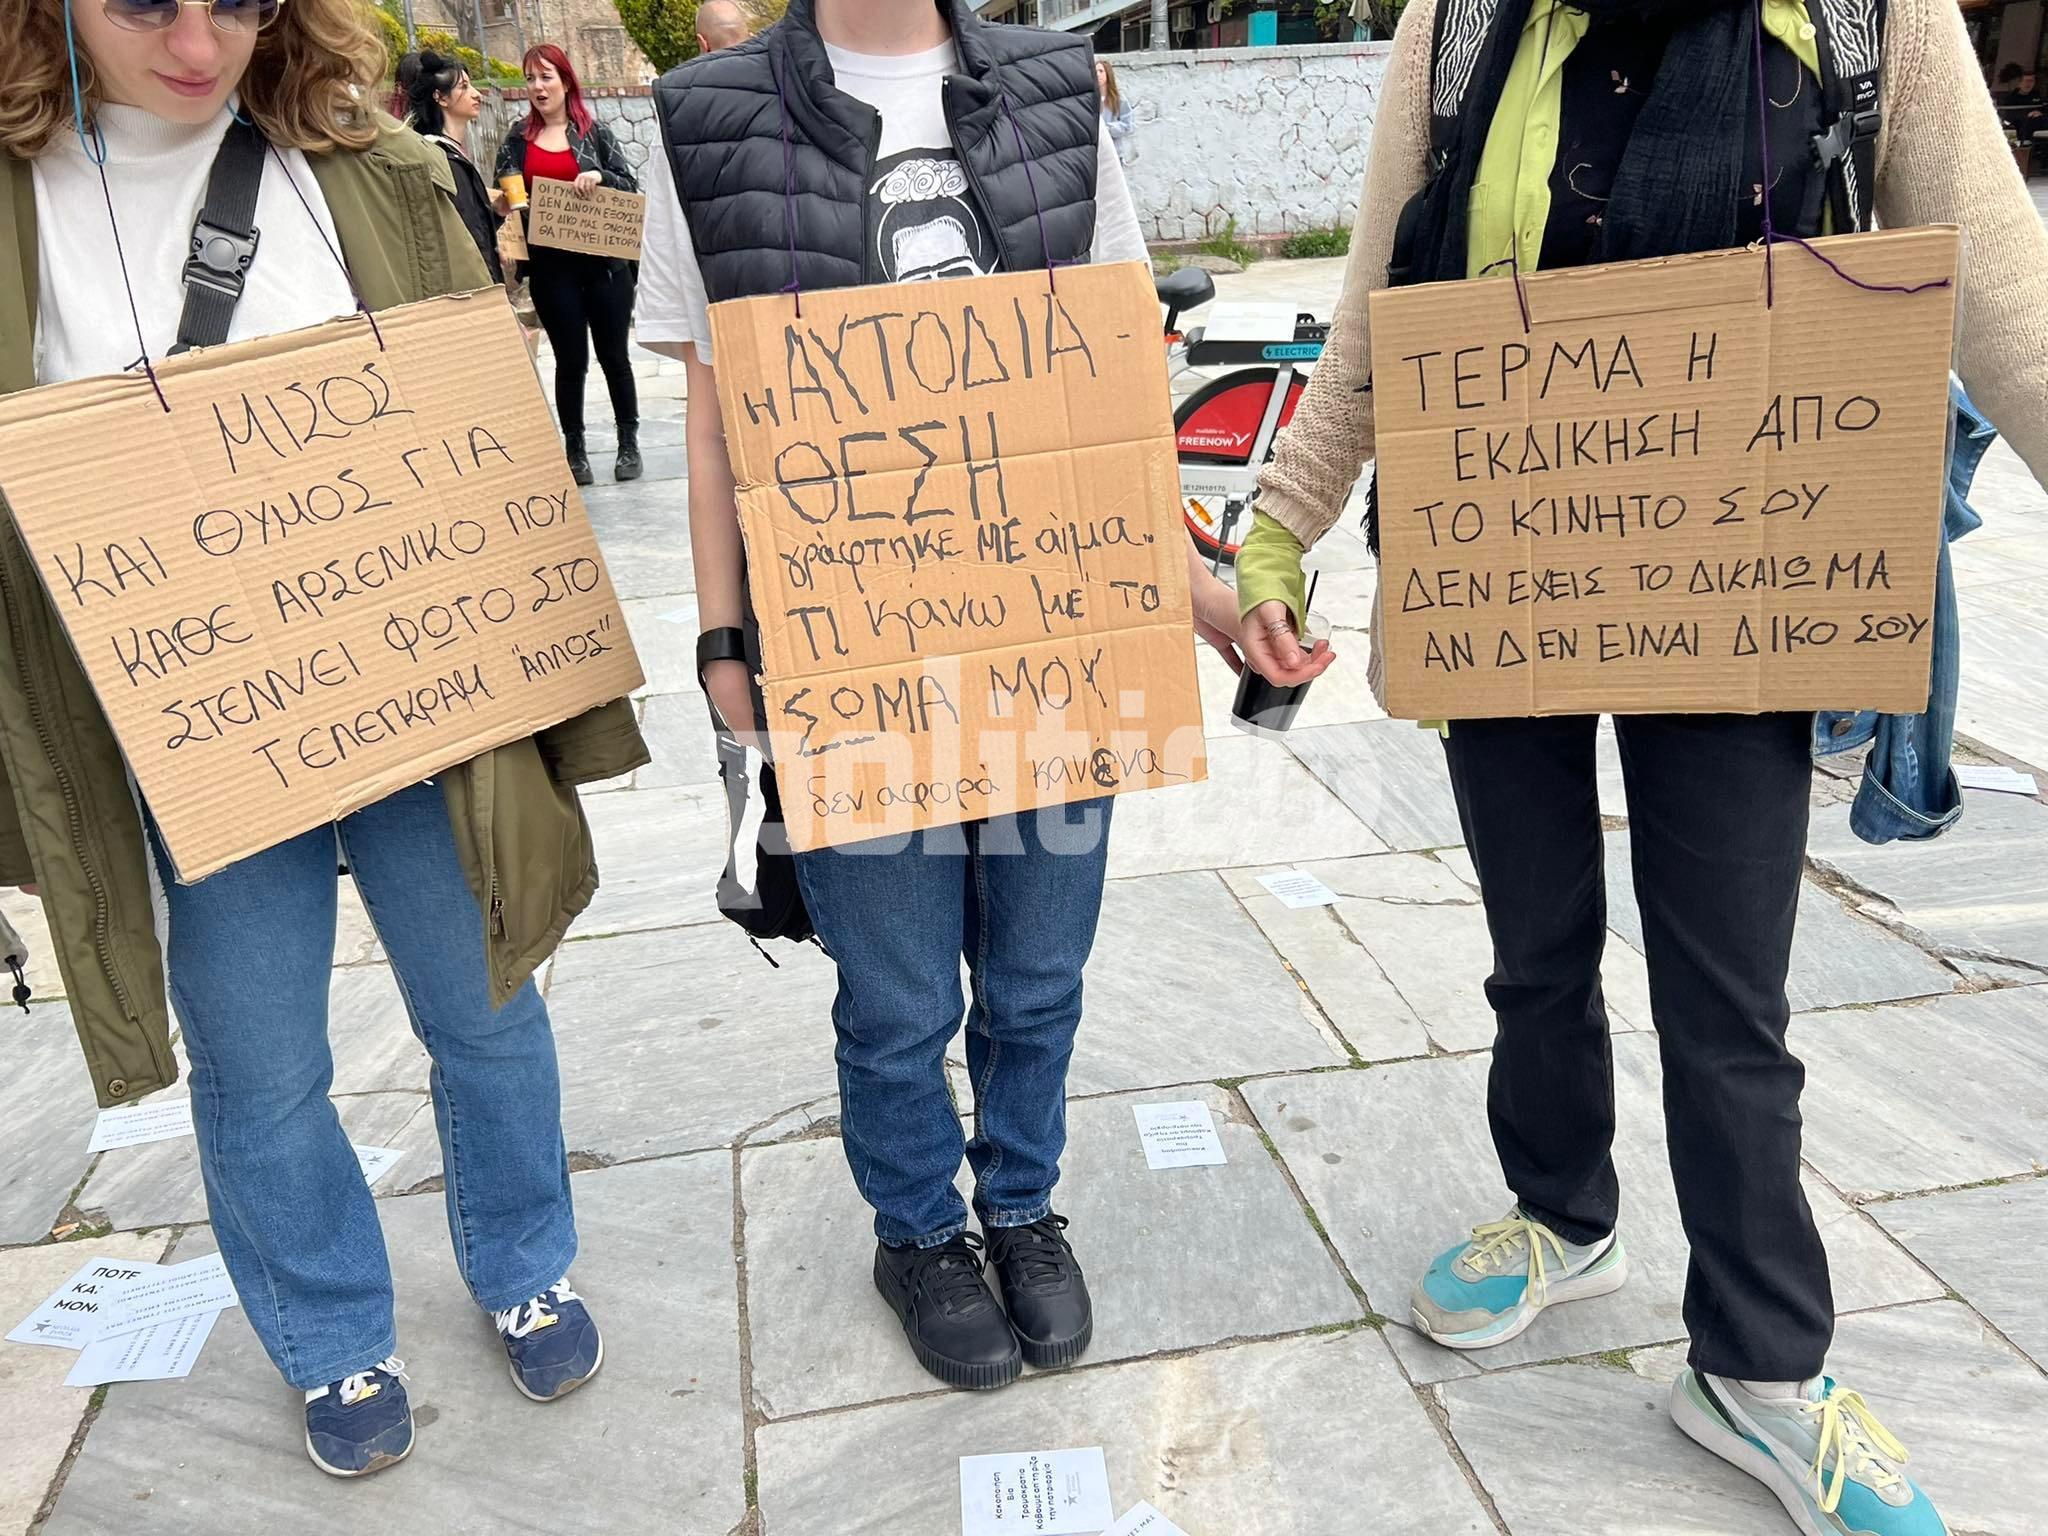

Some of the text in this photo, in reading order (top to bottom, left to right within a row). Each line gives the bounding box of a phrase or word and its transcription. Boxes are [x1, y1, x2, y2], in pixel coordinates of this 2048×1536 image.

[538, 197, 562, 209] ΔΕΝ
[564, 201, 601, 216] ΔΙΝΟΥΝ
[538, 211, 639, 237] ΤΟ ΔΙΚΟ ΜΑΣ ΟΝΟΜΑ
[539, 225, 556, 239] ΘΑ
[559, 227, 601, 244] ΓΡΑΨΕΙ
[1274, 346, 1319, 358] ELECTRIC
[1402, 332, 1718, 412] ΤΕΡΜΑ Η
[212, 362, 415, 474] ΜΙΣΟΣ
[1178, 436, 1234, 447] FREENOW
[1454, 395, 1881, 482] ΕΚΔΙΚΗΣΗ ΑΠΟ
[774, 411, 1008, 527] ΘΕΣΗ
[54, 427, 515, 606] ΚΑΙ ΘΥΜΟΣ ΓΙΑ
[1414, 483, 1830, 547] ΤΟ ΚΙΝΗΤΟ ΣΟΥ
[111, 489, 570, 688] ΚΑΘΕ ΑΡΣΕΝΙΚΟ ΠΟΥ
[1402, 551, 1892, 613] ΔΕΝ ΕΧΕΙΣ ΤΟ ΔΙΚΑΙΩΜΑ
[161, 557, 601, 750] ΣΤΕΛΝΕΙ ΦΩΤΟ ΣΤΟ
[1424, 613, 1931, 673] ΑΝ ΔΕΝ ΕΙΝΑΙ ΔΙΚΟ ΣΟΥ
[990, 648, 1109, 716] ΜΟΥ
[807, 775, 864, 818] δεν
